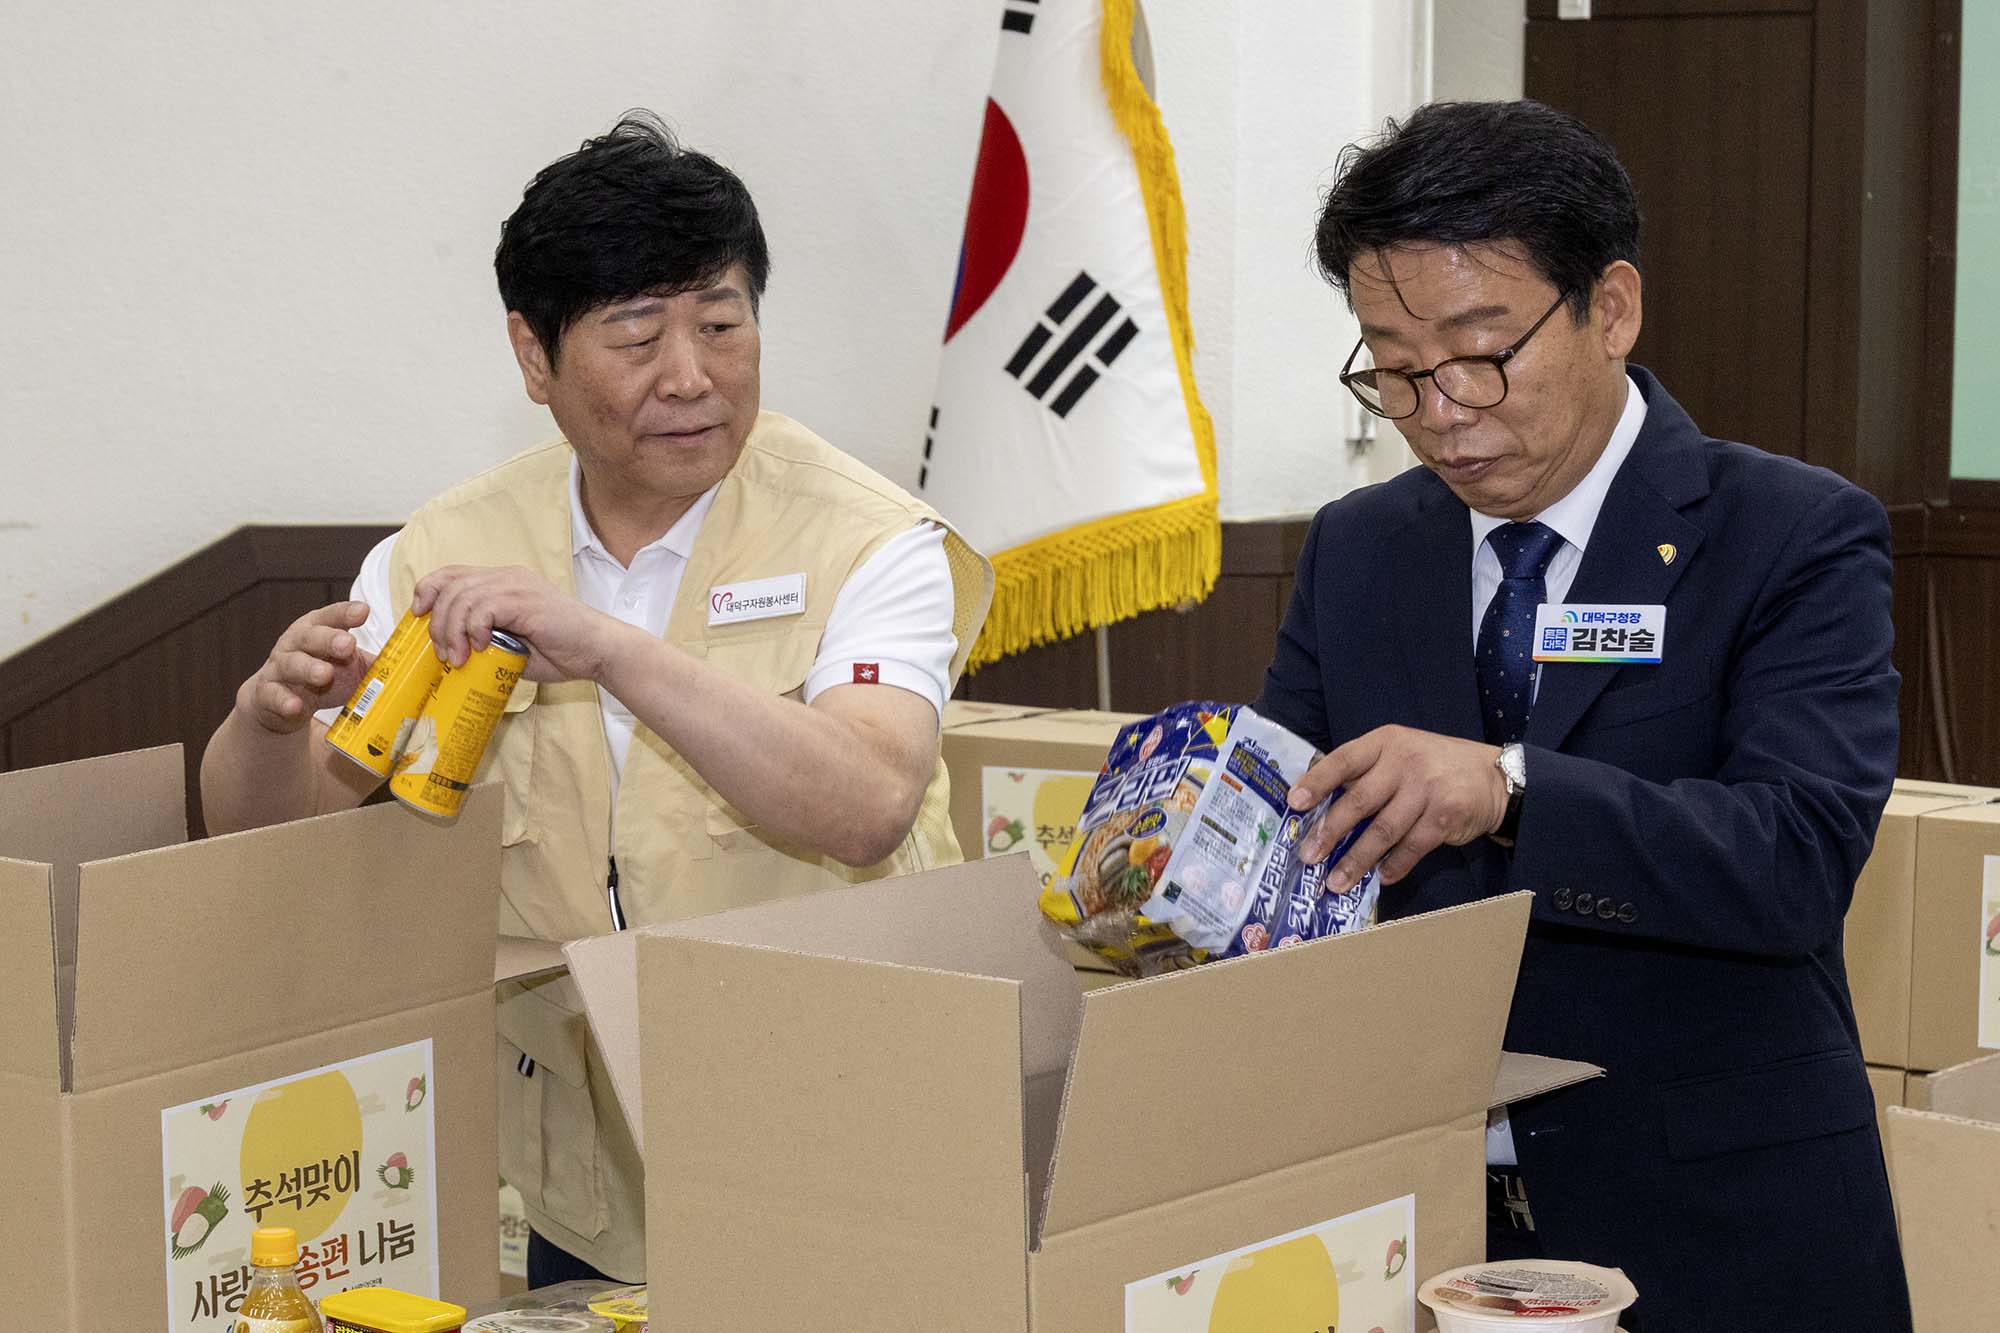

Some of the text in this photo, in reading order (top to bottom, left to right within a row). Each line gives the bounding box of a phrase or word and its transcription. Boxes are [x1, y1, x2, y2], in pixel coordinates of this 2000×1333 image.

[725, 592, 799, 613] 대덕구자원봉사센터
[1582, 612, 1642, 624] 대덕구청장
[1543, 640, 1565, 650] 대덕
[1572, 627, 1655, 652] 김찬술
[1036, 824, 1075, 850] 추석
[243, 1149, 361, 1224] 추석맞이
[190, 1218, 416, 1322] 사랑 송편 나눔
